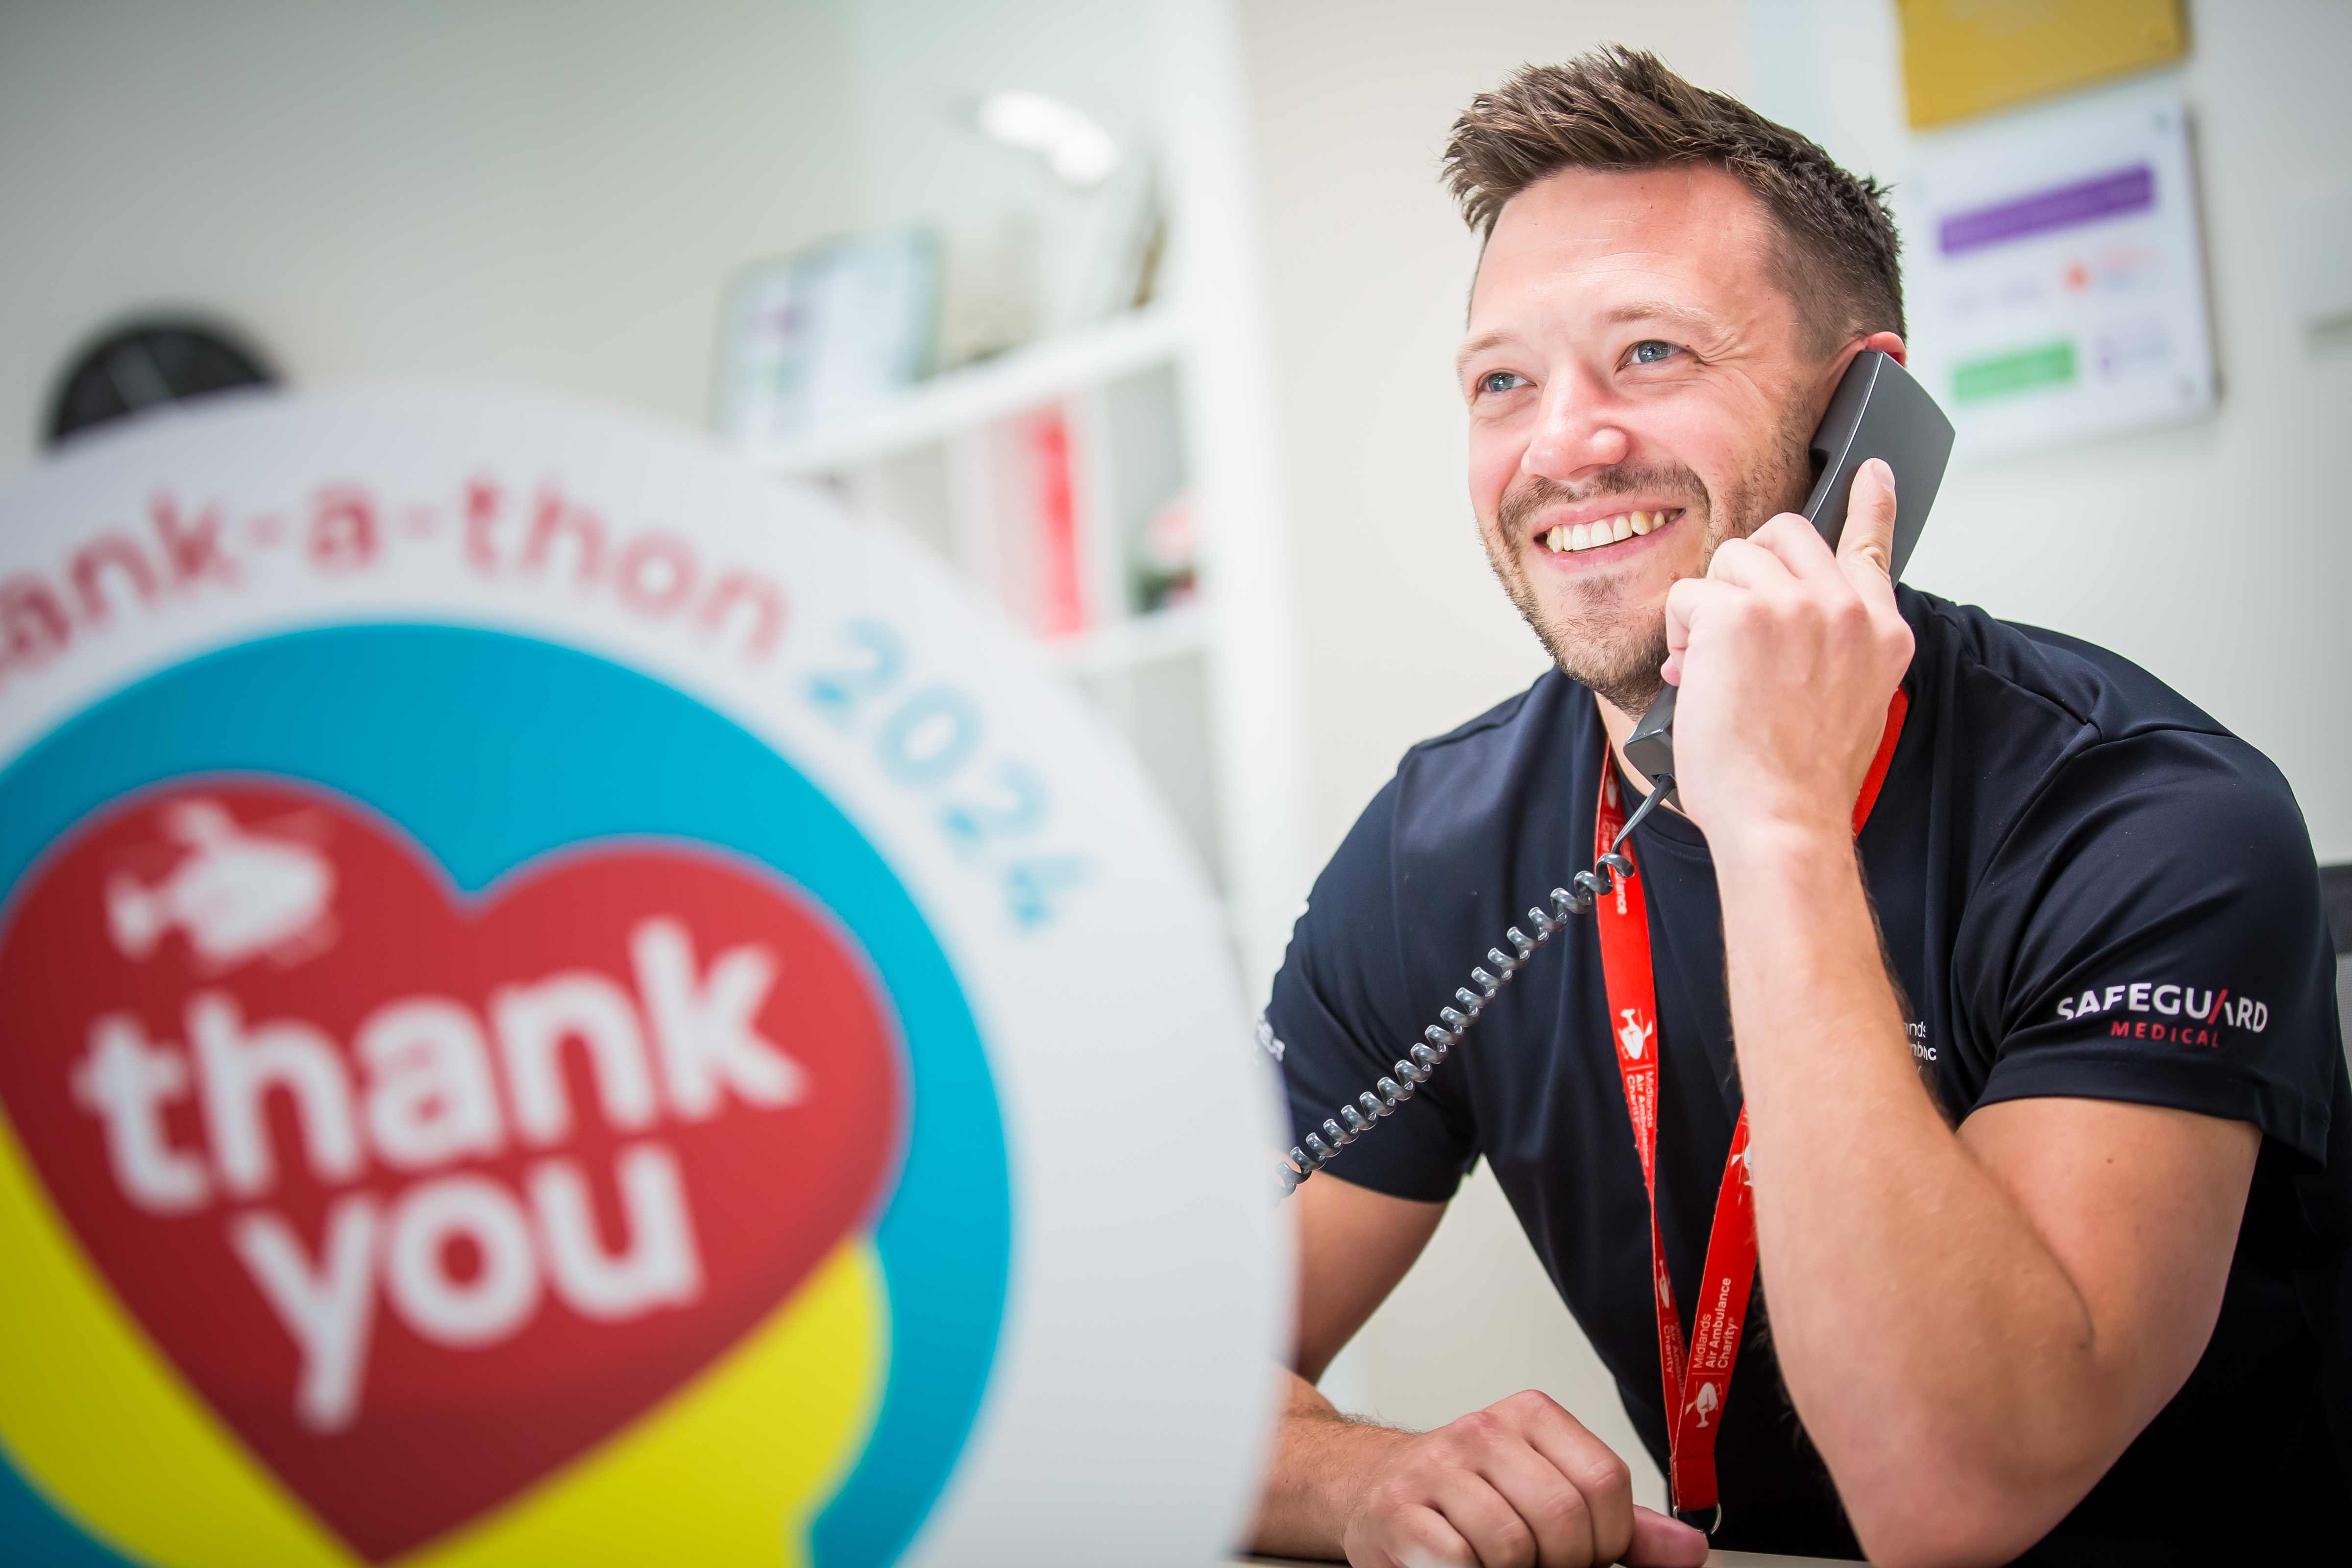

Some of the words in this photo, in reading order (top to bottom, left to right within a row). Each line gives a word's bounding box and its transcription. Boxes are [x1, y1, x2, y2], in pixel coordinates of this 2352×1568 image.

[0, 478, 788, 688] ank-a-thon
[803, 615, 1097, 931] 2024
[2058, 982, 2268, 1033] SAFEGUARD
[2110, 1021, 2219, 1048] MEDICAL
[70, 914, 811, 1213] thank
[1636, 1074, 1644, 1092] Air
[1627, 1075, 1640, 1123] Charity
[1646, 1071, 1654, 1128] Midlands
[231, 1141, 702, 1432] you
[1709, 1277, 1731, 1349] Ambulance
[1692, 1313, 1712, 1369] Midlands
[1705, 1350, 1717, 1369] Air
